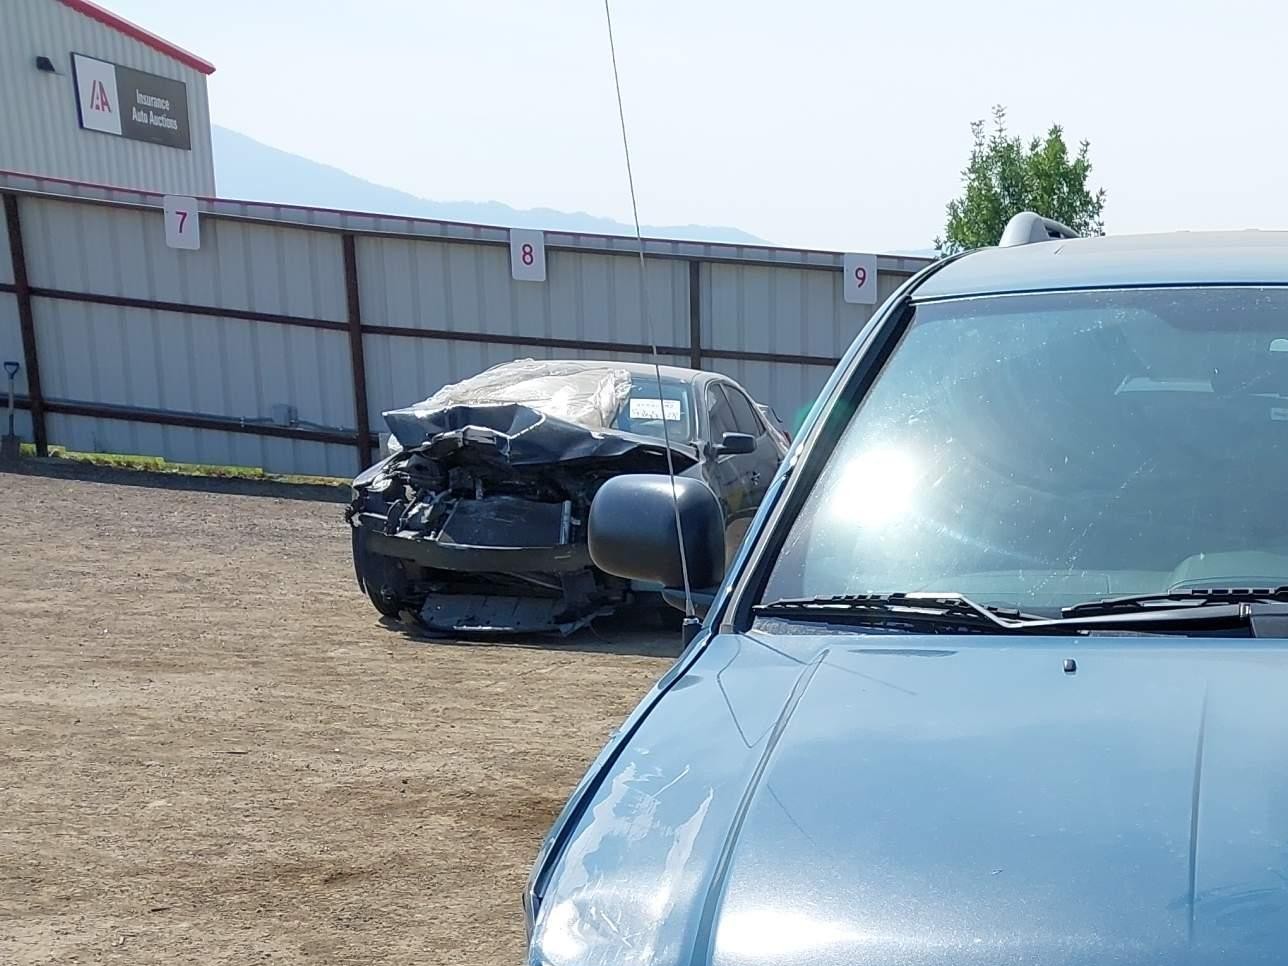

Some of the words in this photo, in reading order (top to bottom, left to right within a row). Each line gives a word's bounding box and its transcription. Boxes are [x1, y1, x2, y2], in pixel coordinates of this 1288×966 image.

[136, 89, 169, 111] Insurance
[132, 106, 149, 124] Auto
[149, 110, 178, 130] Auctions
[176, 211, 187, 233] 7
[522, 244, 533, 265] 8
[855, 267, 866, 288] 9
